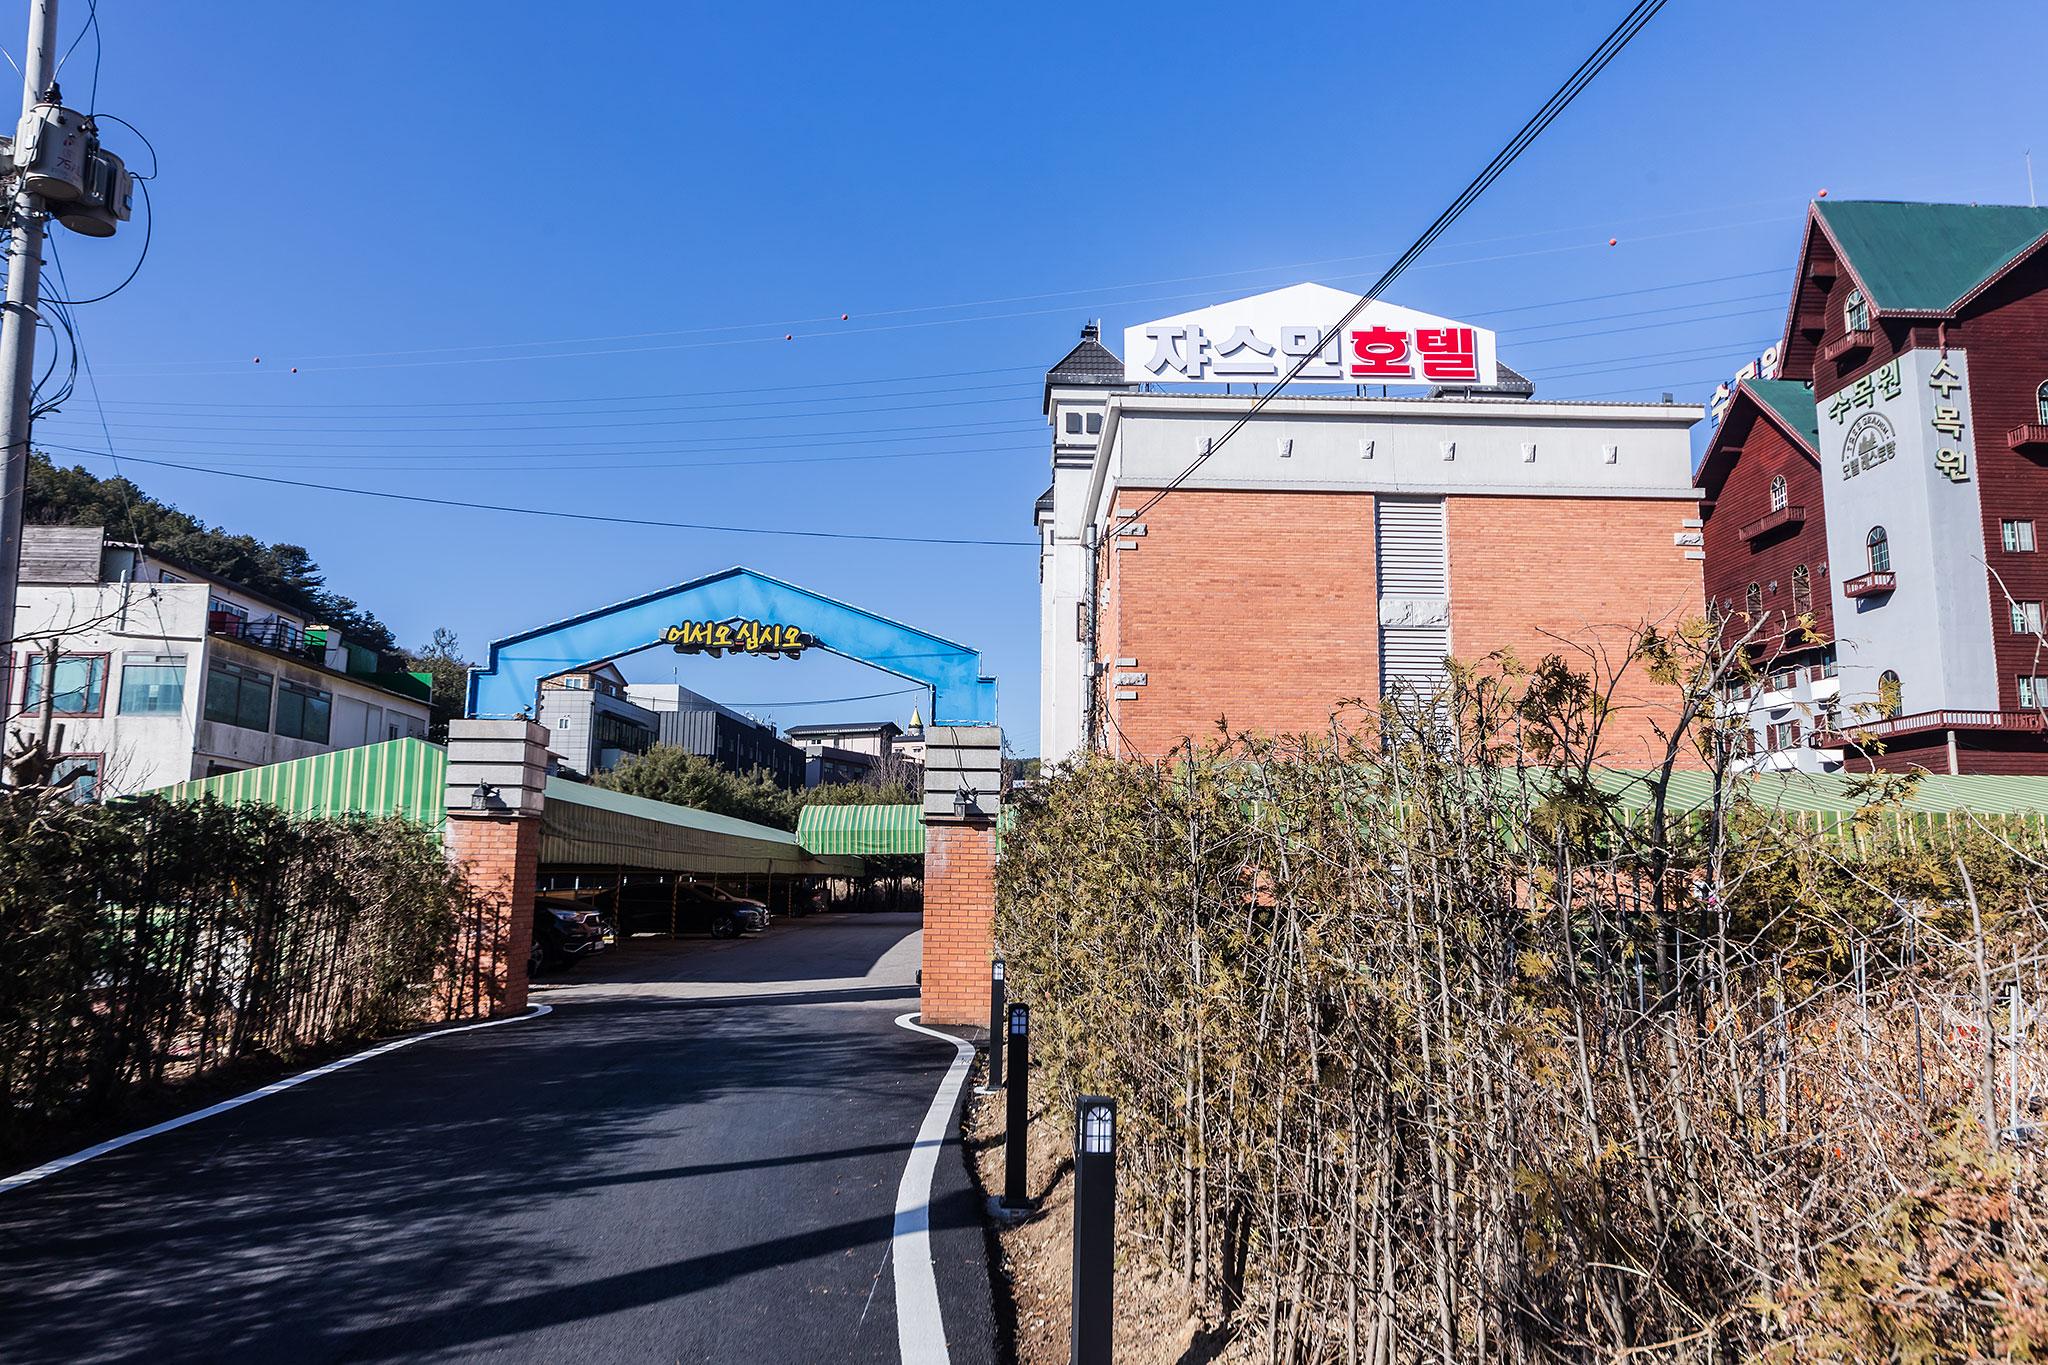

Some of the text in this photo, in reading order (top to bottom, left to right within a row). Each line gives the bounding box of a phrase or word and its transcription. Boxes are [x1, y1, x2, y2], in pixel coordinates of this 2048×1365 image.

[1829, 358, 1902, 425] 수목원
[1929, 359, 1971, 483] 수목원
[1842, 440, 1897, 480] 모텔 레스토랑
